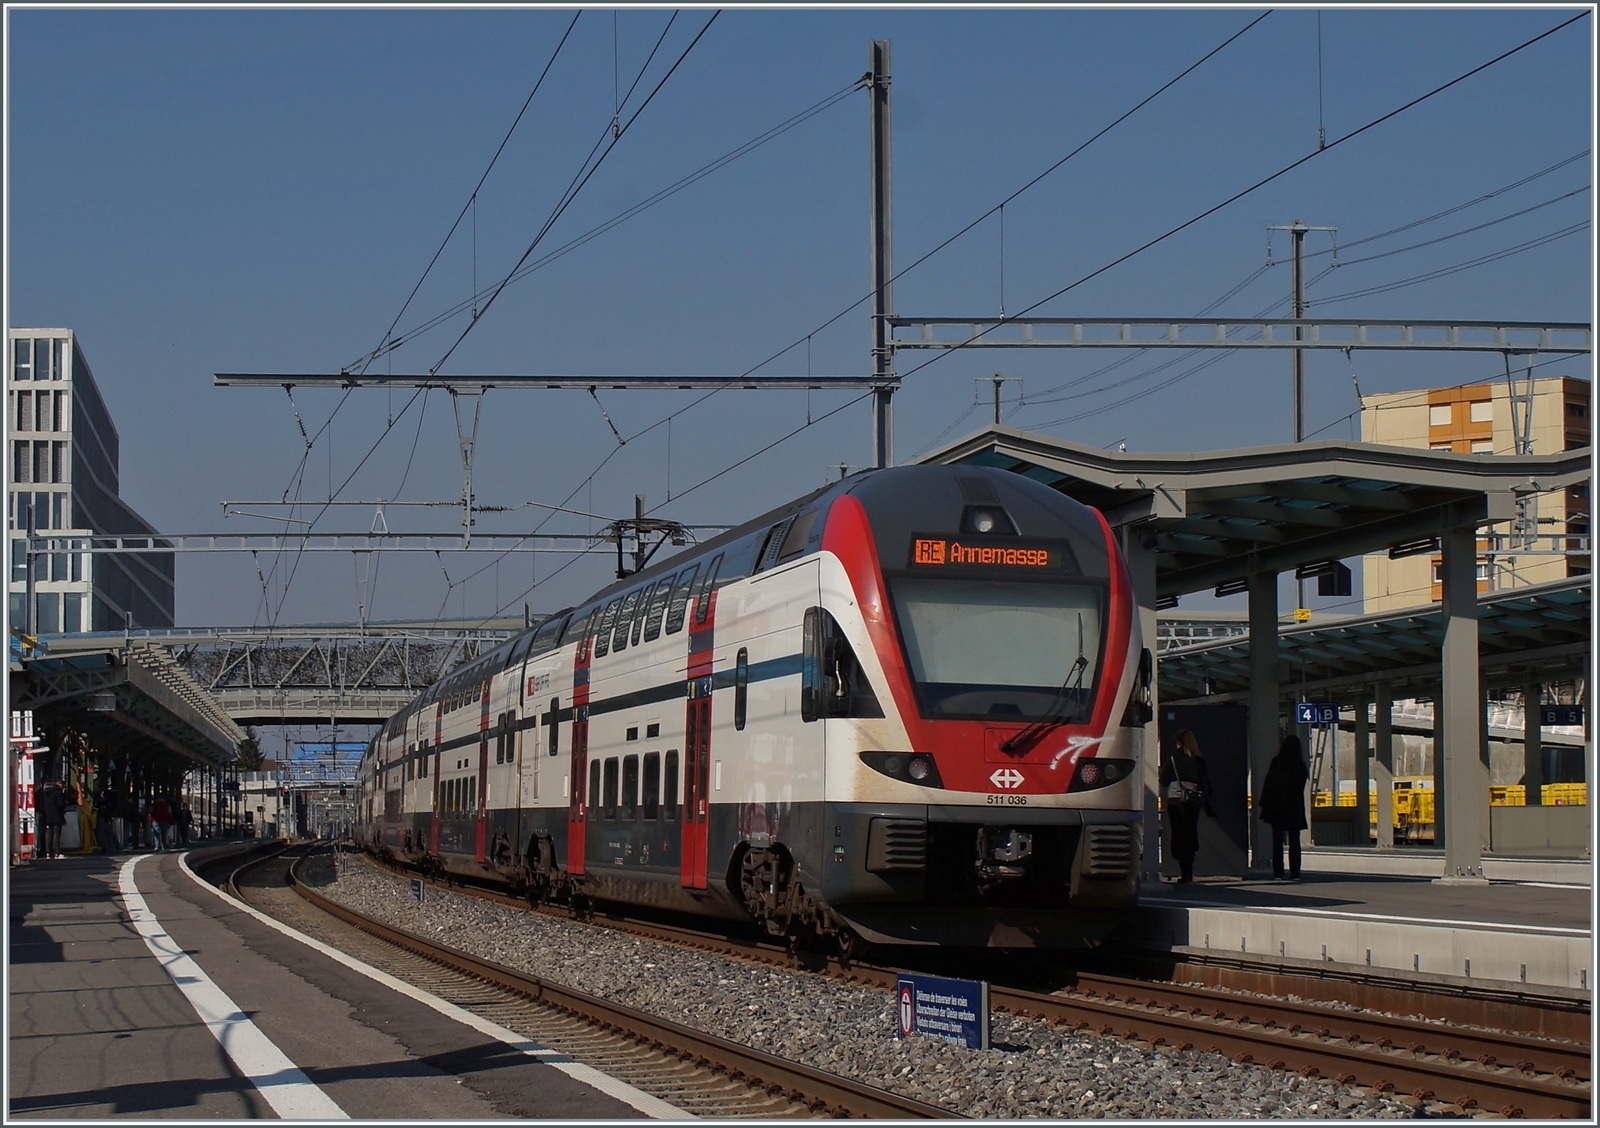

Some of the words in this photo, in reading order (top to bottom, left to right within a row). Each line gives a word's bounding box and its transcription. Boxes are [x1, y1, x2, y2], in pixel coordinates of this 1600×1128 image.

[920, 541, 941, 562] RE
[950, 542, 1048, 566] Annemasse
[1303, 709, 1311, 720] 4
[1324, 709, 1333, 720] B
[1547, 712, 1556, 722] B
[1569, 712, 1576, 722] 5
[987, 795, 1003, 804] 511
[1008, 796, 1027, 804] 036
[958, 996, 967, 1007] voies
